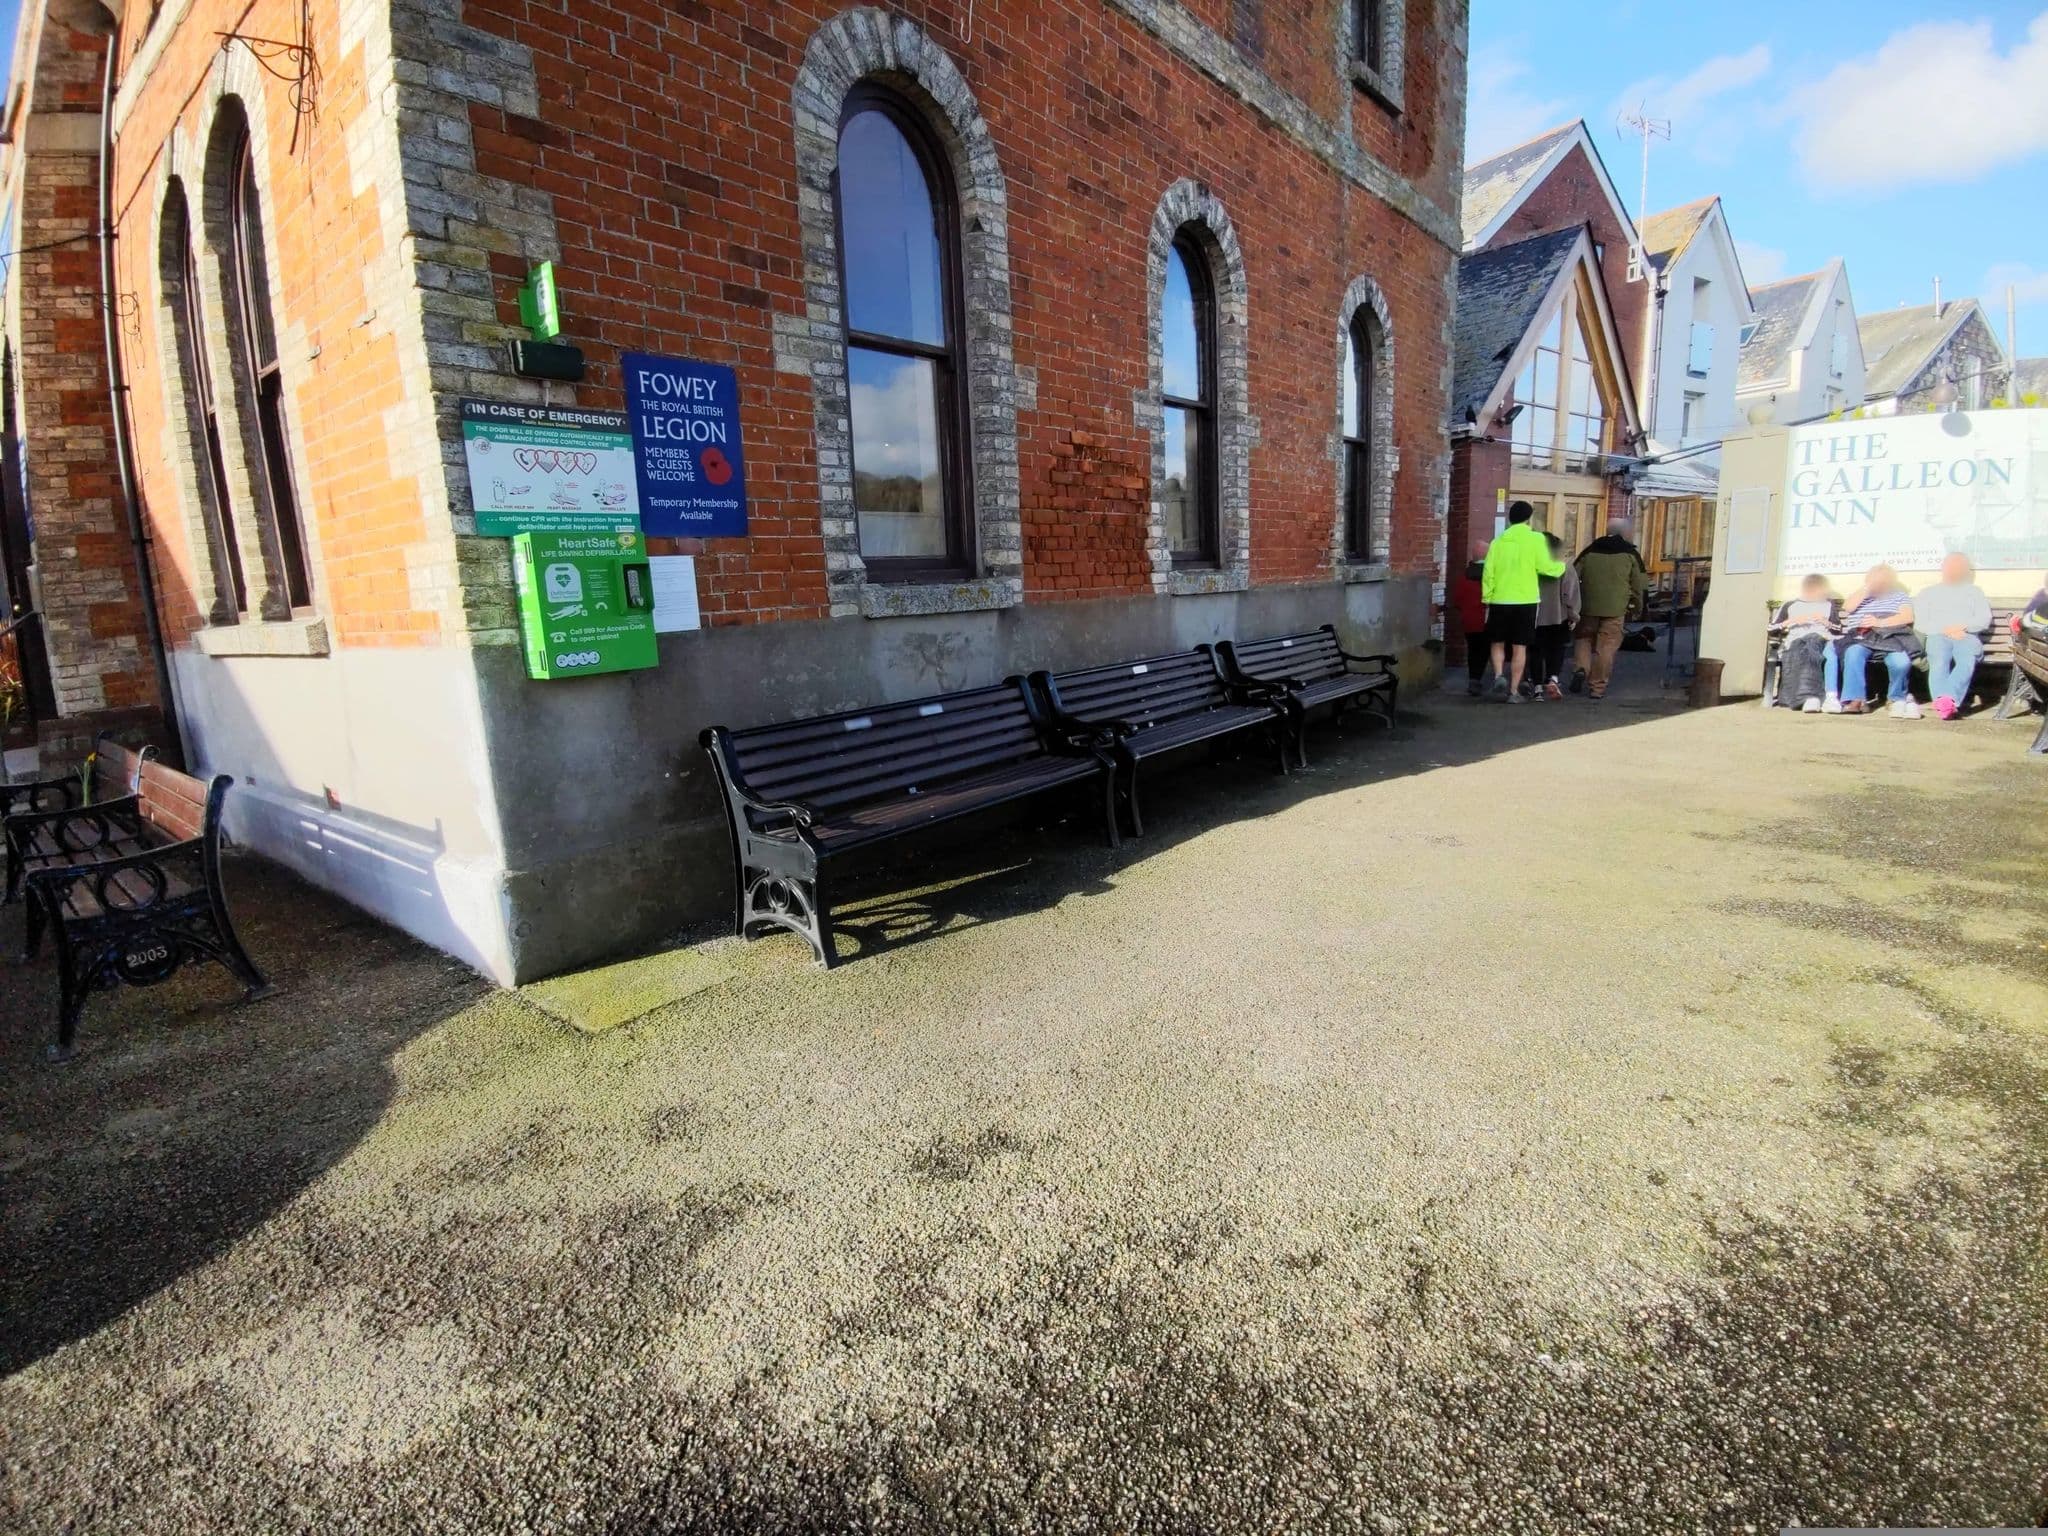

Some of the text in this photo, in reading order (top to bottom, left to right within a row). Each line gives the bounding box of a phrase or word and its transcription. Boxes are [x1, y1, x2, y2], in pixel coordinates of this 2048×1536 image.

[638, 370, 718, 401] FOWEY
[640, 399, 724, 417] THE ROYAL BRITISH
[472, 403, 622, 427] IN CASE OF EMERGENCY
[489, 426, 509, 434] DOOR
[509, 427, 524, 435] WILL
[560, 432, 604, 441] AUTOMATICALLY
[641, 415, 727, 443] LEGION
[494, 434, 533, 442] AMBULANCE
[560, 438, 587, 446] CONTROL
[588, 440, 609, 448] CENTRE
[645, 447, 690, 459] MEMBERS
[1795, 432, 1889, 466] THE
[646, 459, 693, 470] & GUESTS
[647, 470, 696, 482] WELCOME
[1791, 457, 2016, 498] GALLEON
[648, 497, 739, 509] Temporary Membership
[680, 511, 713, 520] Available
[1790, 497, 1881, 529] INN
[573, 524, 587, 532] help
[558, 537, 617, 549] HeartSafe
[541, 548, 637, 558] LIFE SAVING DEFIBRILLATOR
[569, 627, 583, 635] Call
[606, 624, 629, 632] Access
[630, 623, 646, 631] Code
[579, 635, 596, 644] open
[597, 633, 620, 641] cabinet
[126, 945, 168, 968] 2003
